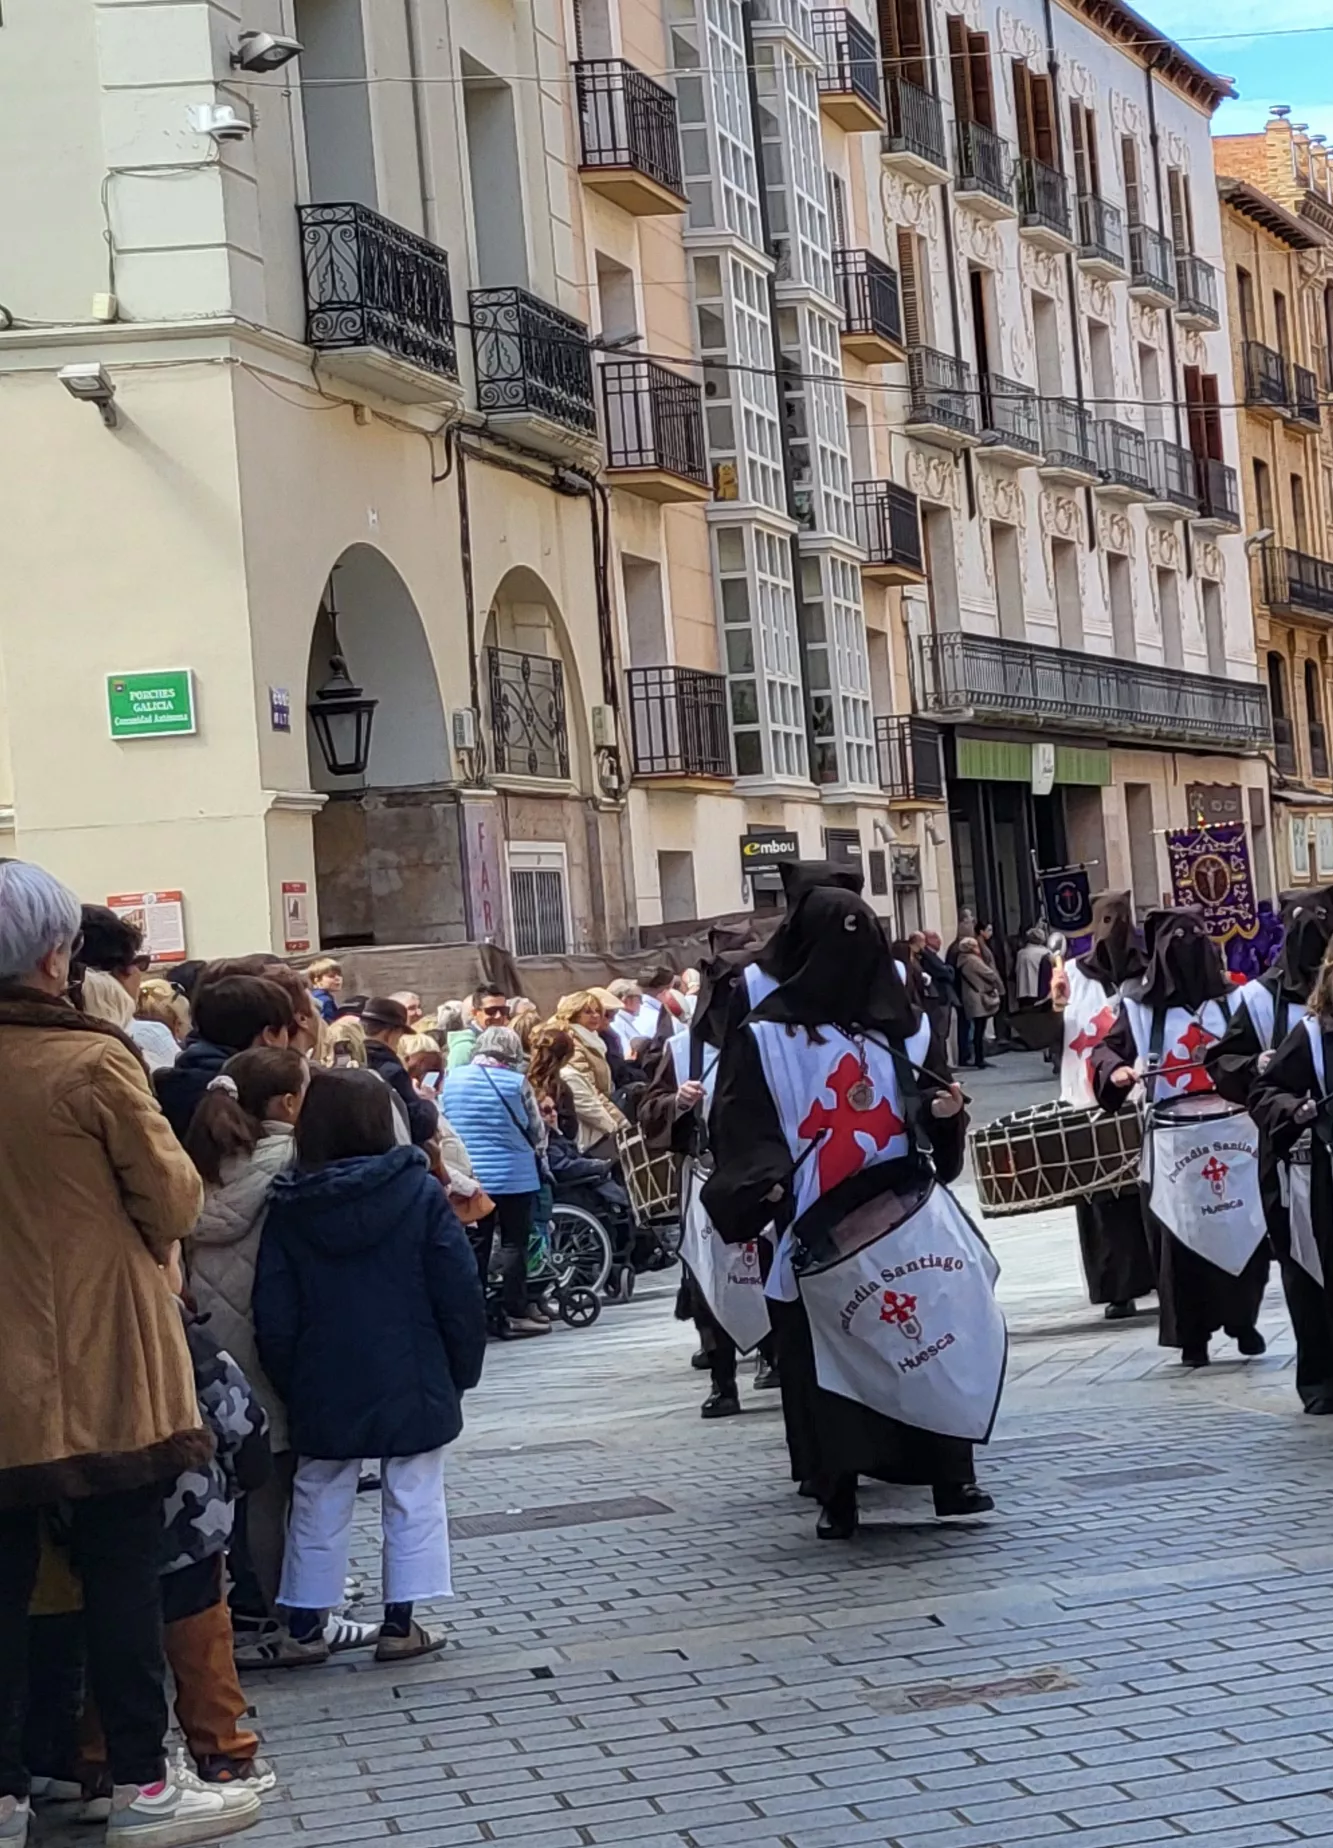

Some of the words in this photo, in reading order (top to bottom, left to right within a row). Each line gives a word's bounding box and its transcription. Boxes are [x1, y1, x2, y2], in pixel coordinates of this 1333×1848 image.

[128, 687, 176, 702] PORCHES
[132, 700, 174, 713] GALICIA
[743, 839, 796, 856] embou
[1200, 1198, 1244, 1216] Huesca
[880, 1252, 964, 1283] Santiago
[897, 1332, 956, 1374] Huesca
